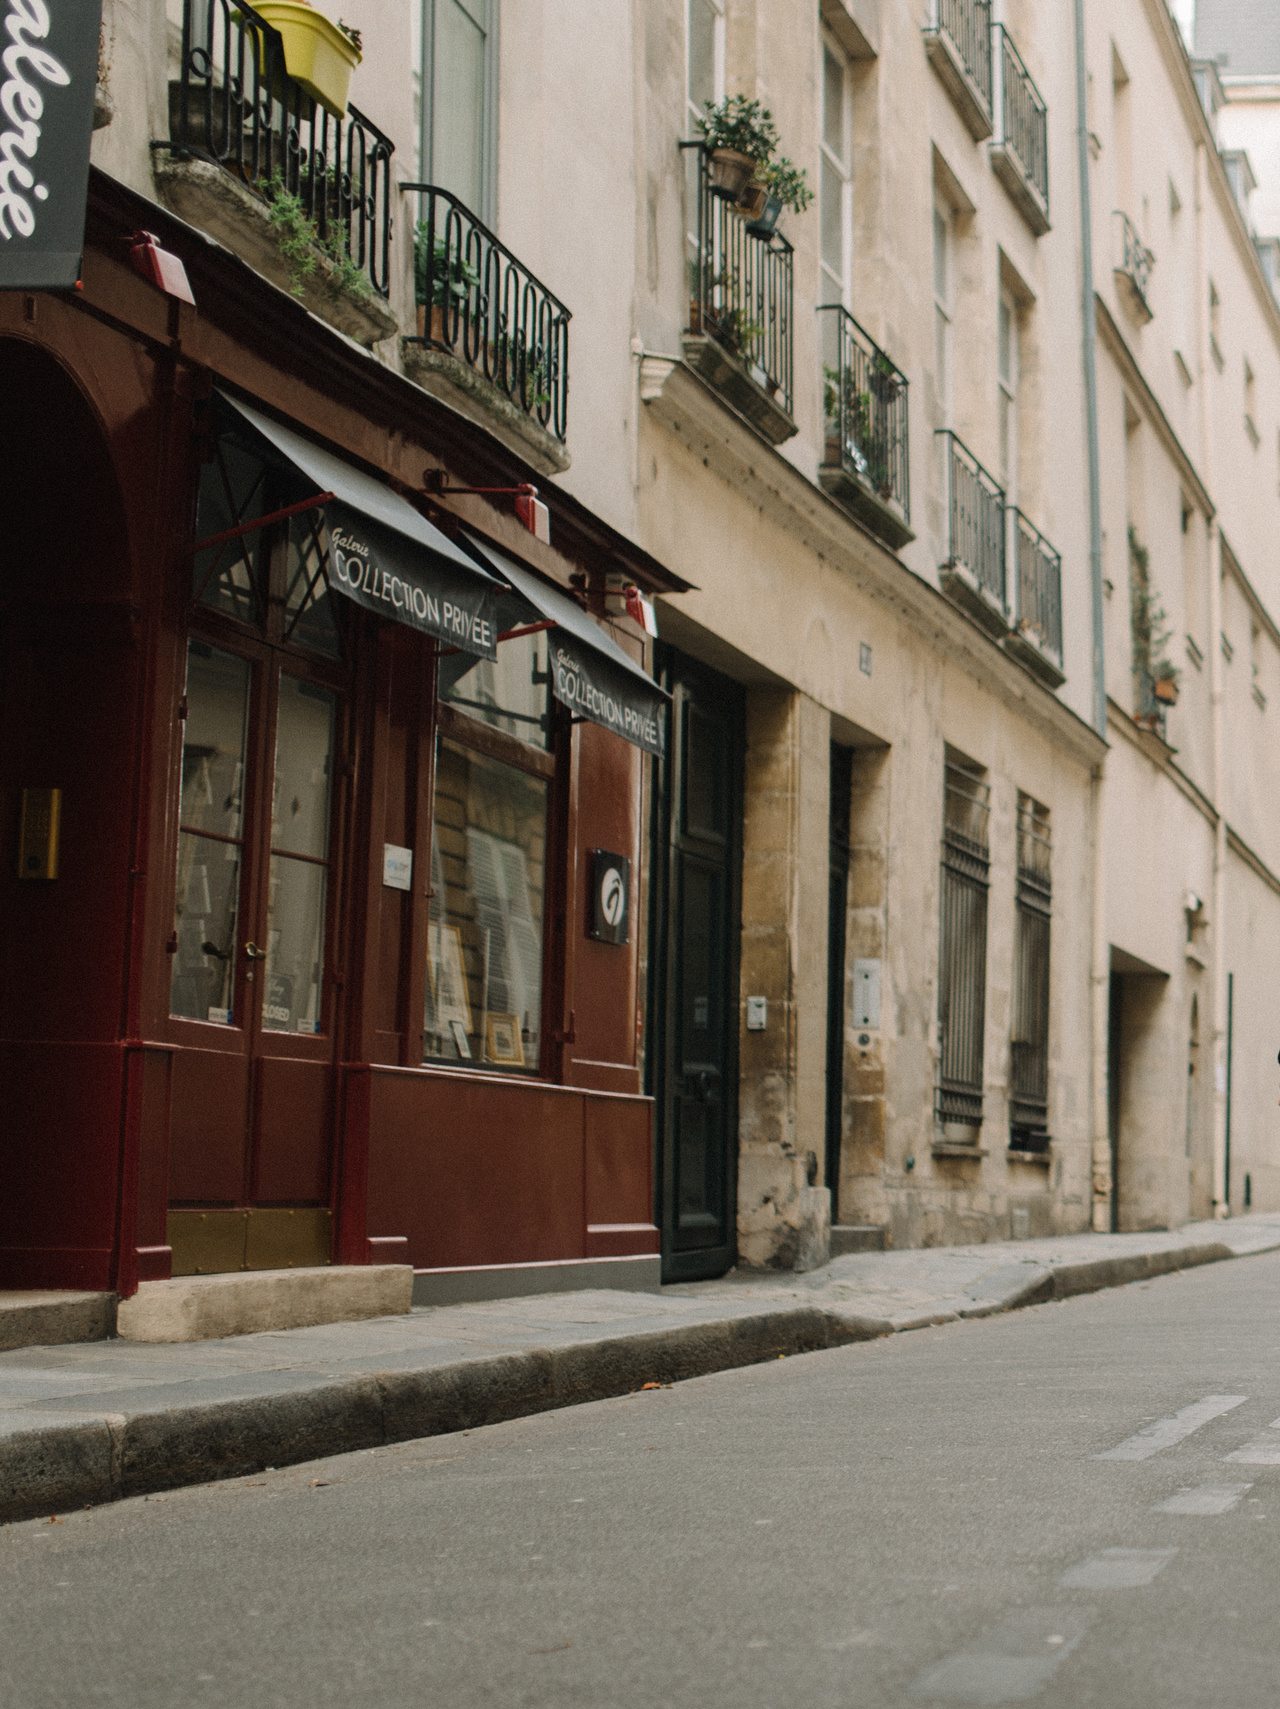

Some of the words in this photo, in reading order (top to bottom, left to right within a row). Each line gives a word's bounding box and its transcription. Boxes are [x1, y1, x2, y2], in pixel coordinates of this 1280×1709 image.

[331, 527, 369, 557] Galerie
[335, 549, 440, 625] COLLECTION
[443, 601, 491, 648] PRIVEE
[558, 667, 624, 726] COLLECTION
[624, 707, 657, 745] PRIVEE
